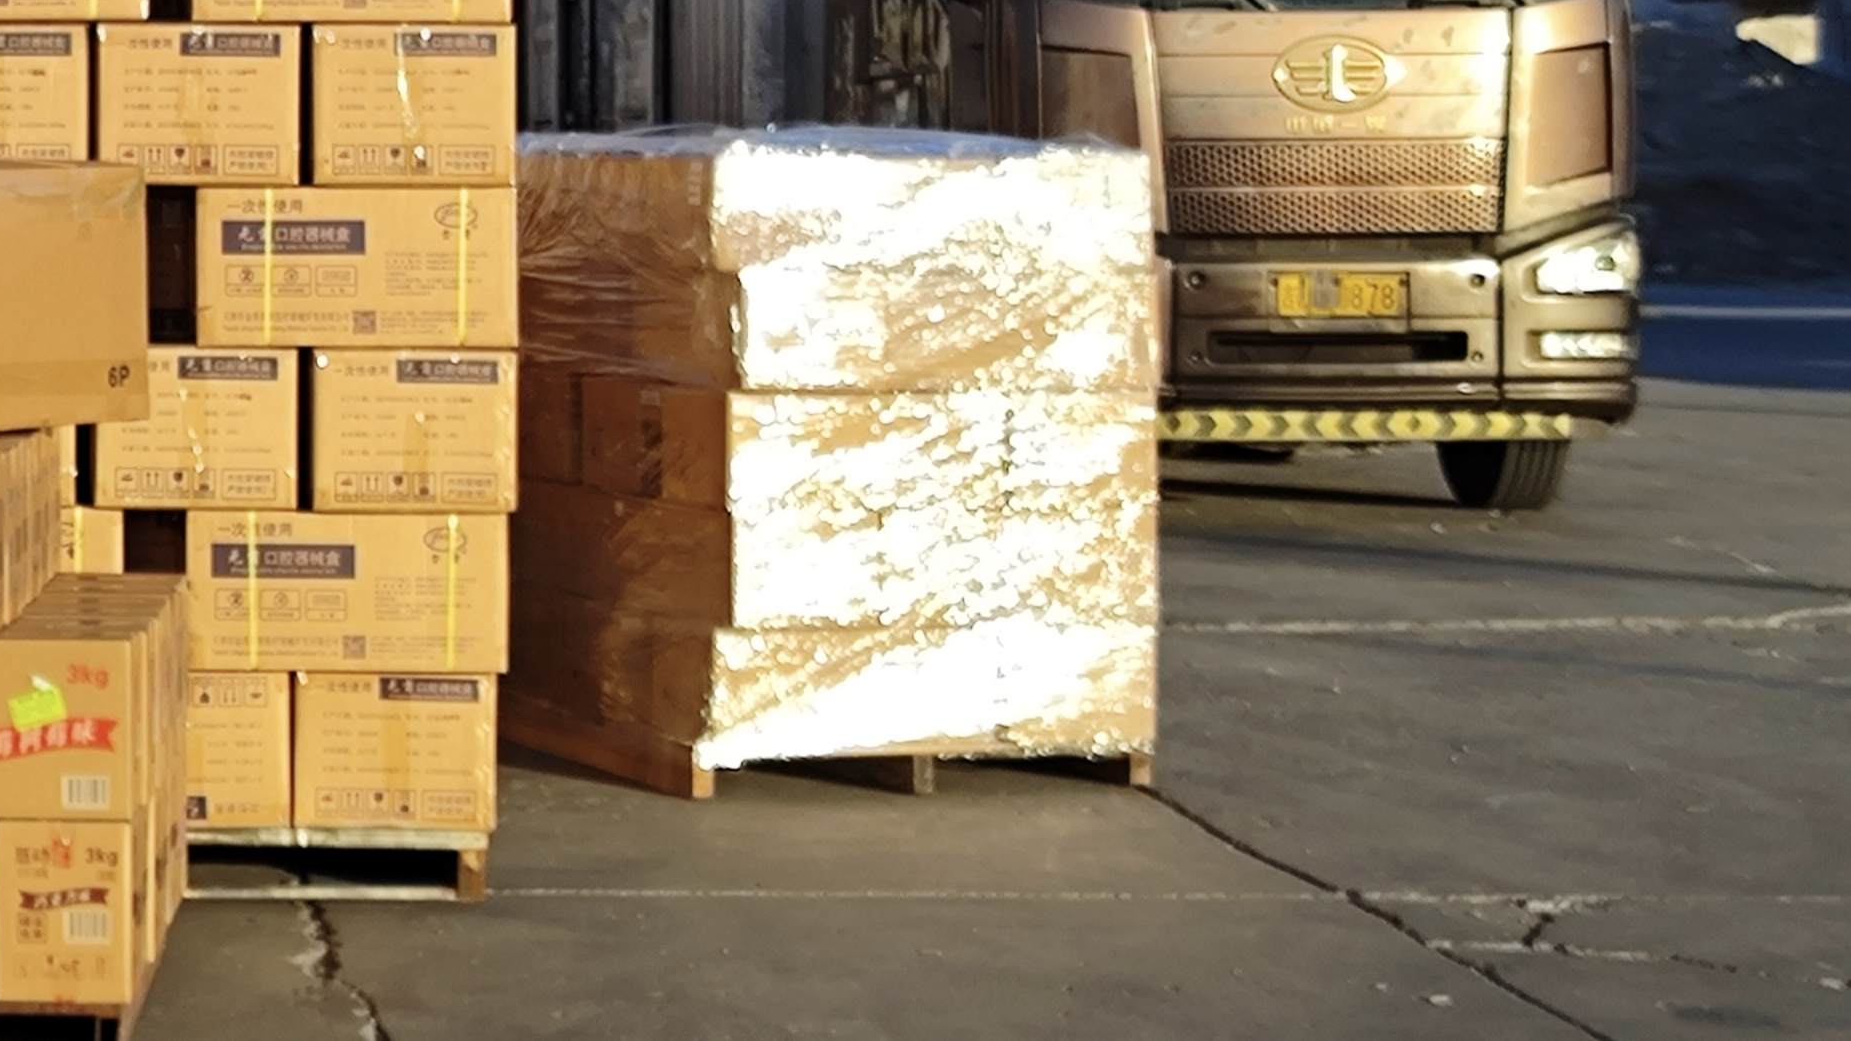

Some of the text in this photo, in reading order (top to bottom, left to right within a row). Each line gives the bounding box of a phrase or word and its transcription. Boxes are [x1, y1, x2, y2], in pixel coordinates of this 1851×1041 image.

[107, 365, 130, 389] 6P
[66, 664, 109, 688] 3kg
[85, 847, 117, 867] 3kg
